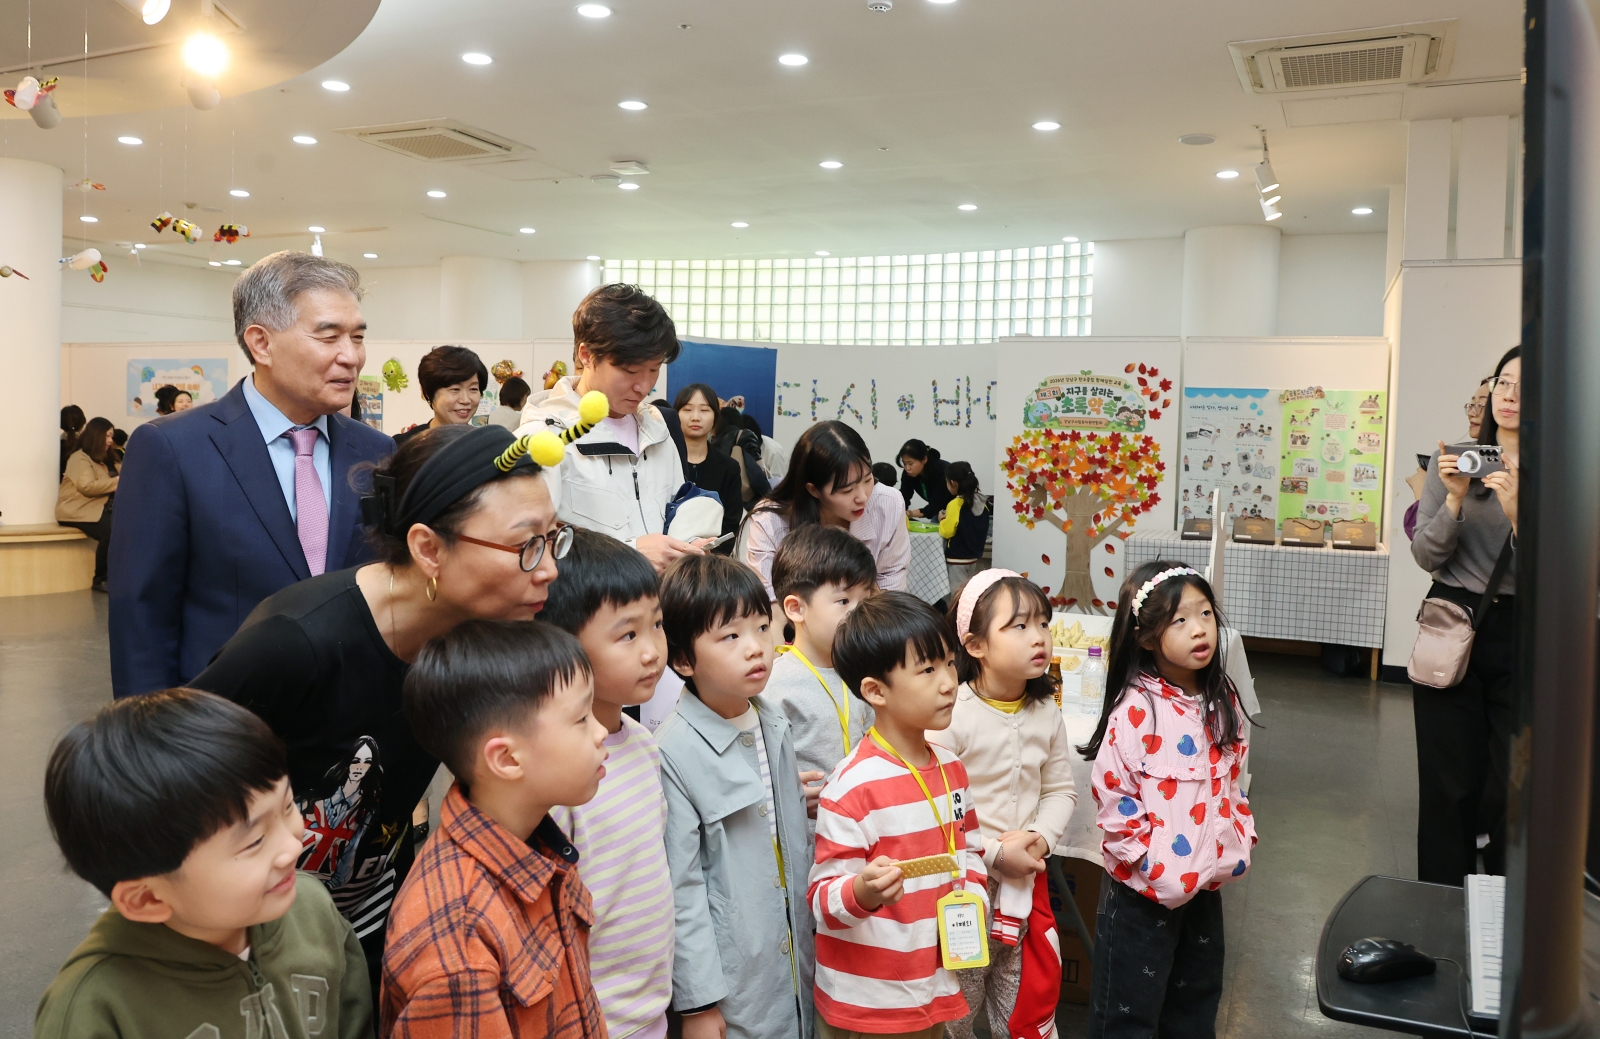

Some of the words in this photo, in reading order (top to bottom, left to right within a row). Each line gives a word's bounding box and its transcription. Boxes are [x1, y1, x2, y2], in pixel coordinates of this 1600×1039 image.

[1040, 390, 1058, 398] 제3회
[1066, 386, 1088, 396] 지구를
[1090, 386, 1114, 398] 살리는
